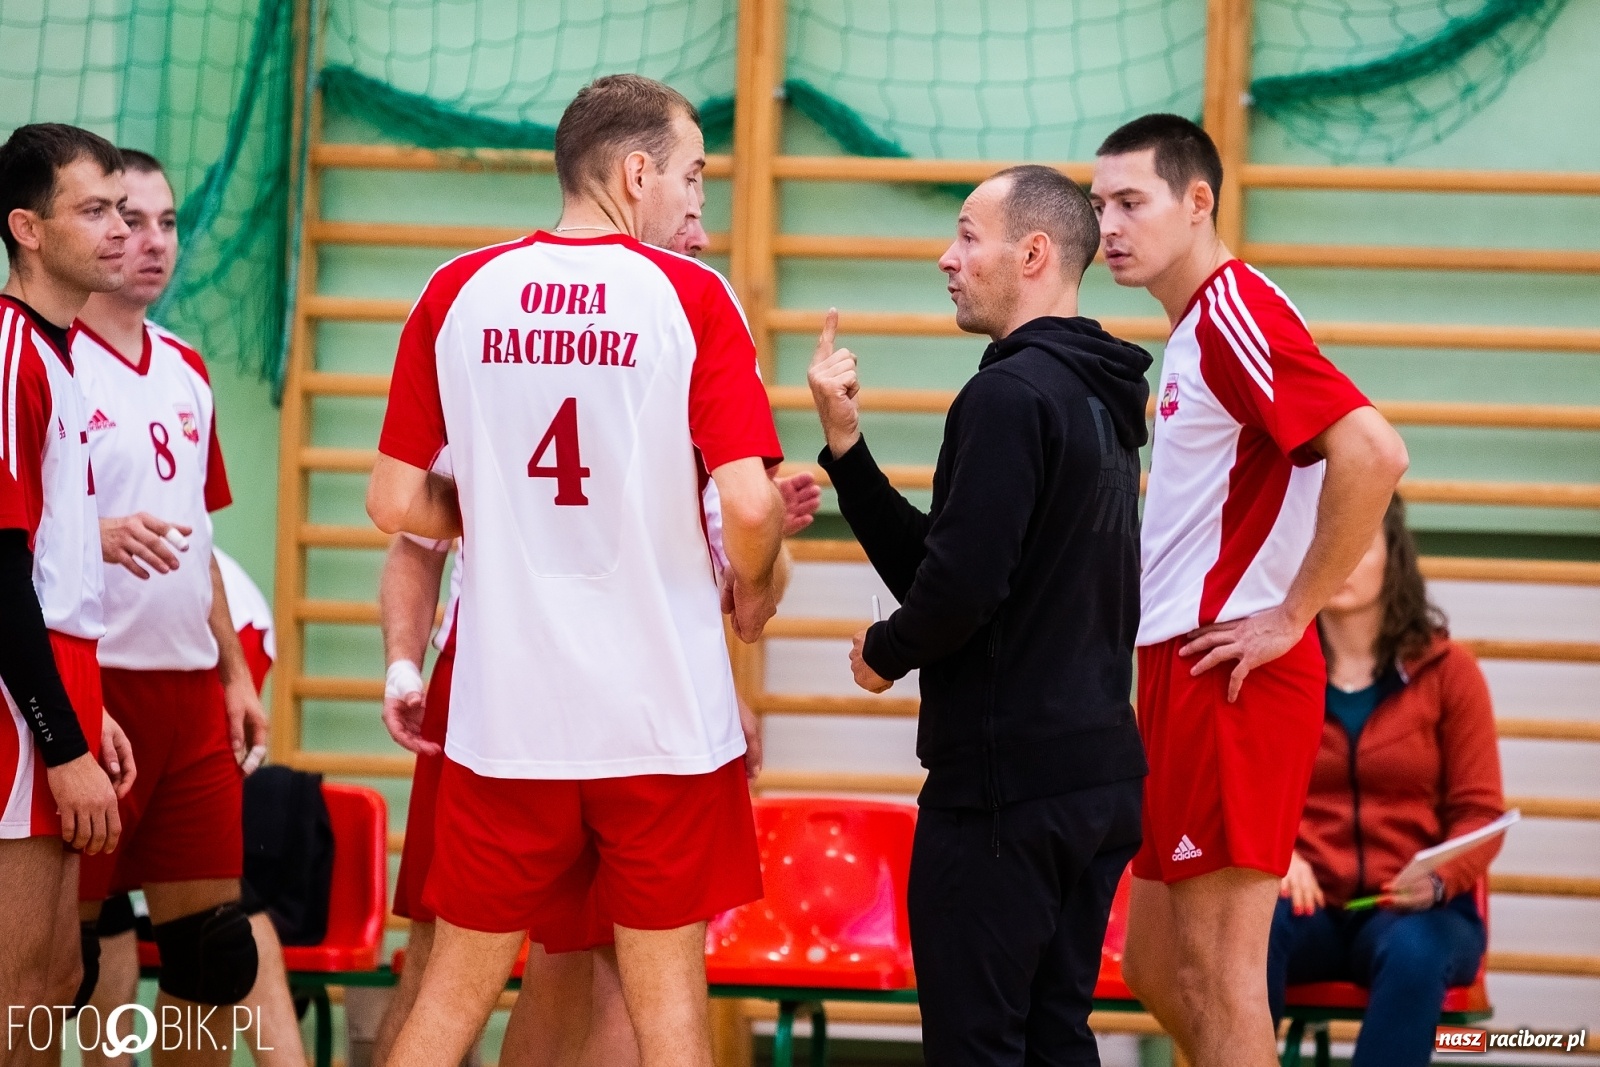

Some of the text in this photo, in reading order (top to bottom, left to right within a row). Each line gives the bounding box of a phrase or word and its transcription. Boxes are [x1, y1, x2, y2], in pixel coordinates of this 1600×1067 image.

[520, 282, 606, 314] ODRA
[481, 323, 639, 367] RACIBÓRZ
[149, 422, 176, 481] 8
[527, 397, 590, 506] 4
[29, 696, 53, 742] KIPSTA
[1171, 848, 1203, 861] adidas
